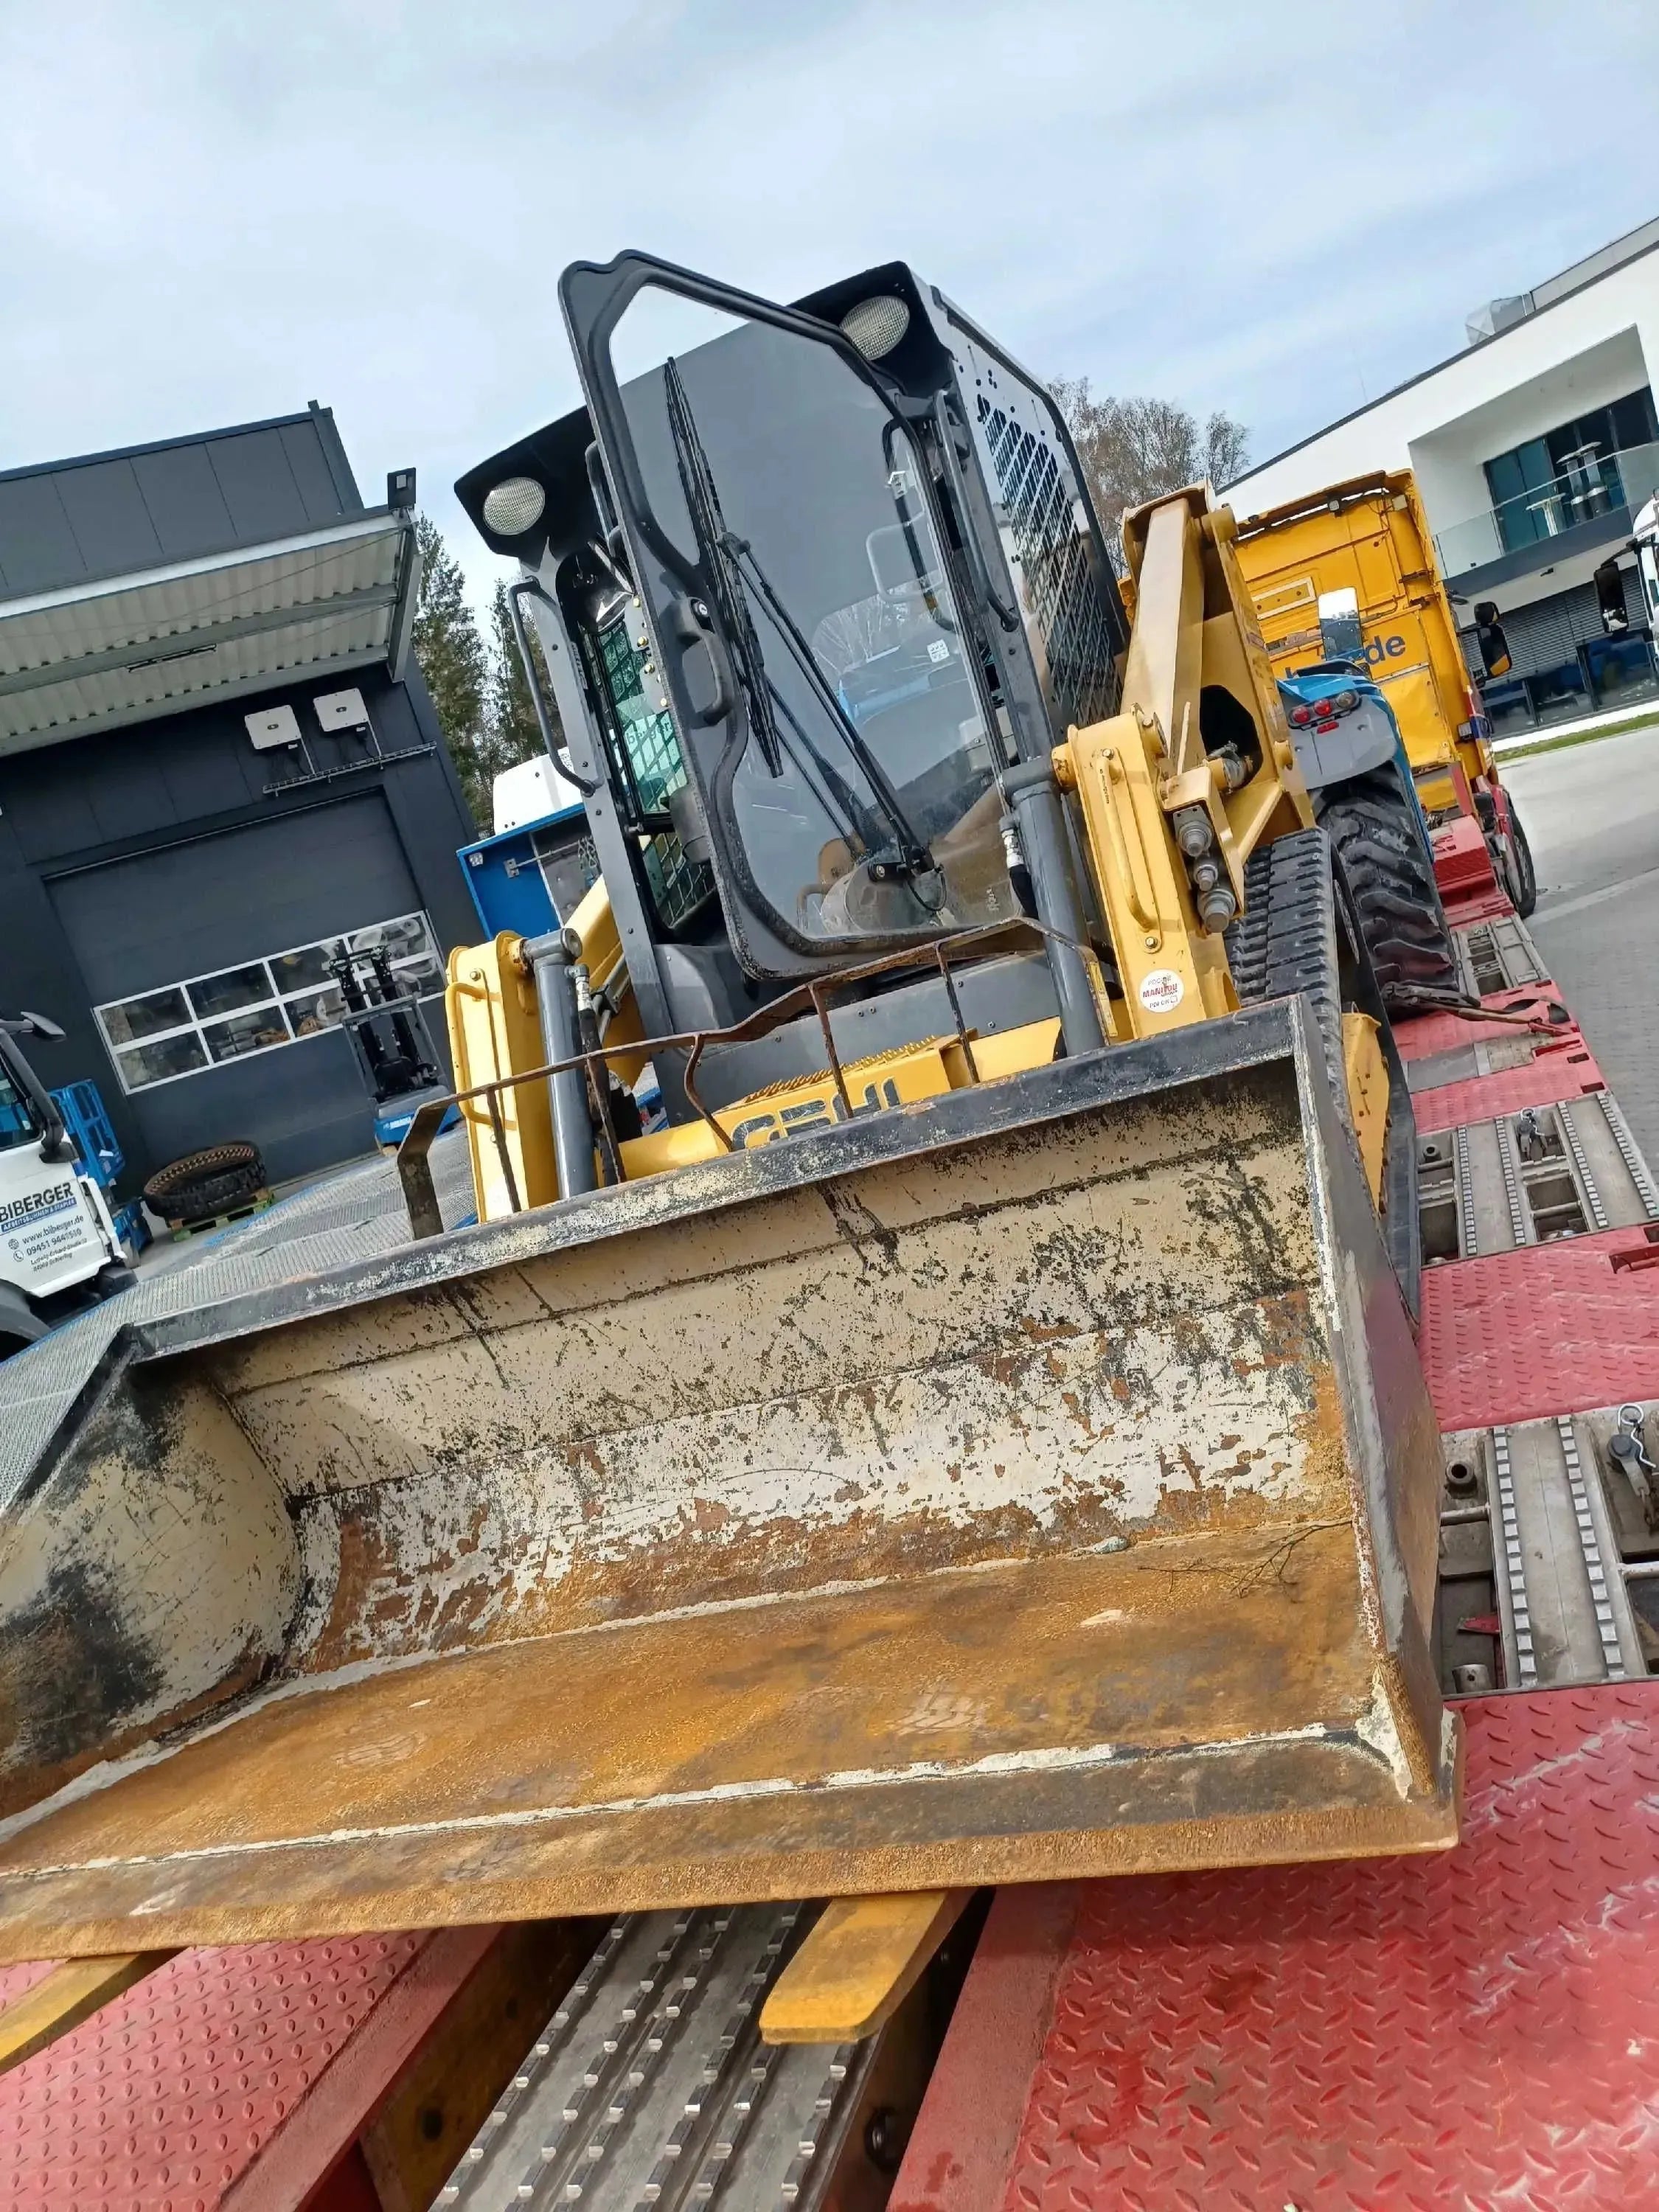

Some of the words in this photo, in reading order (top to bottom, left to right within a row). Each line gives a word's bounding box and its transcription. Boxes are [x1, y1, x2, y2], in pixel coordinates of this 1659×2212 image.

[1143, 983, 1178, 998] MANITOU
[0, 1182, 74, 1222] BIBERGER
[22, 1215, 84, 1244] www.biberger.de
[26, 1240, 50, 1256] 09451
